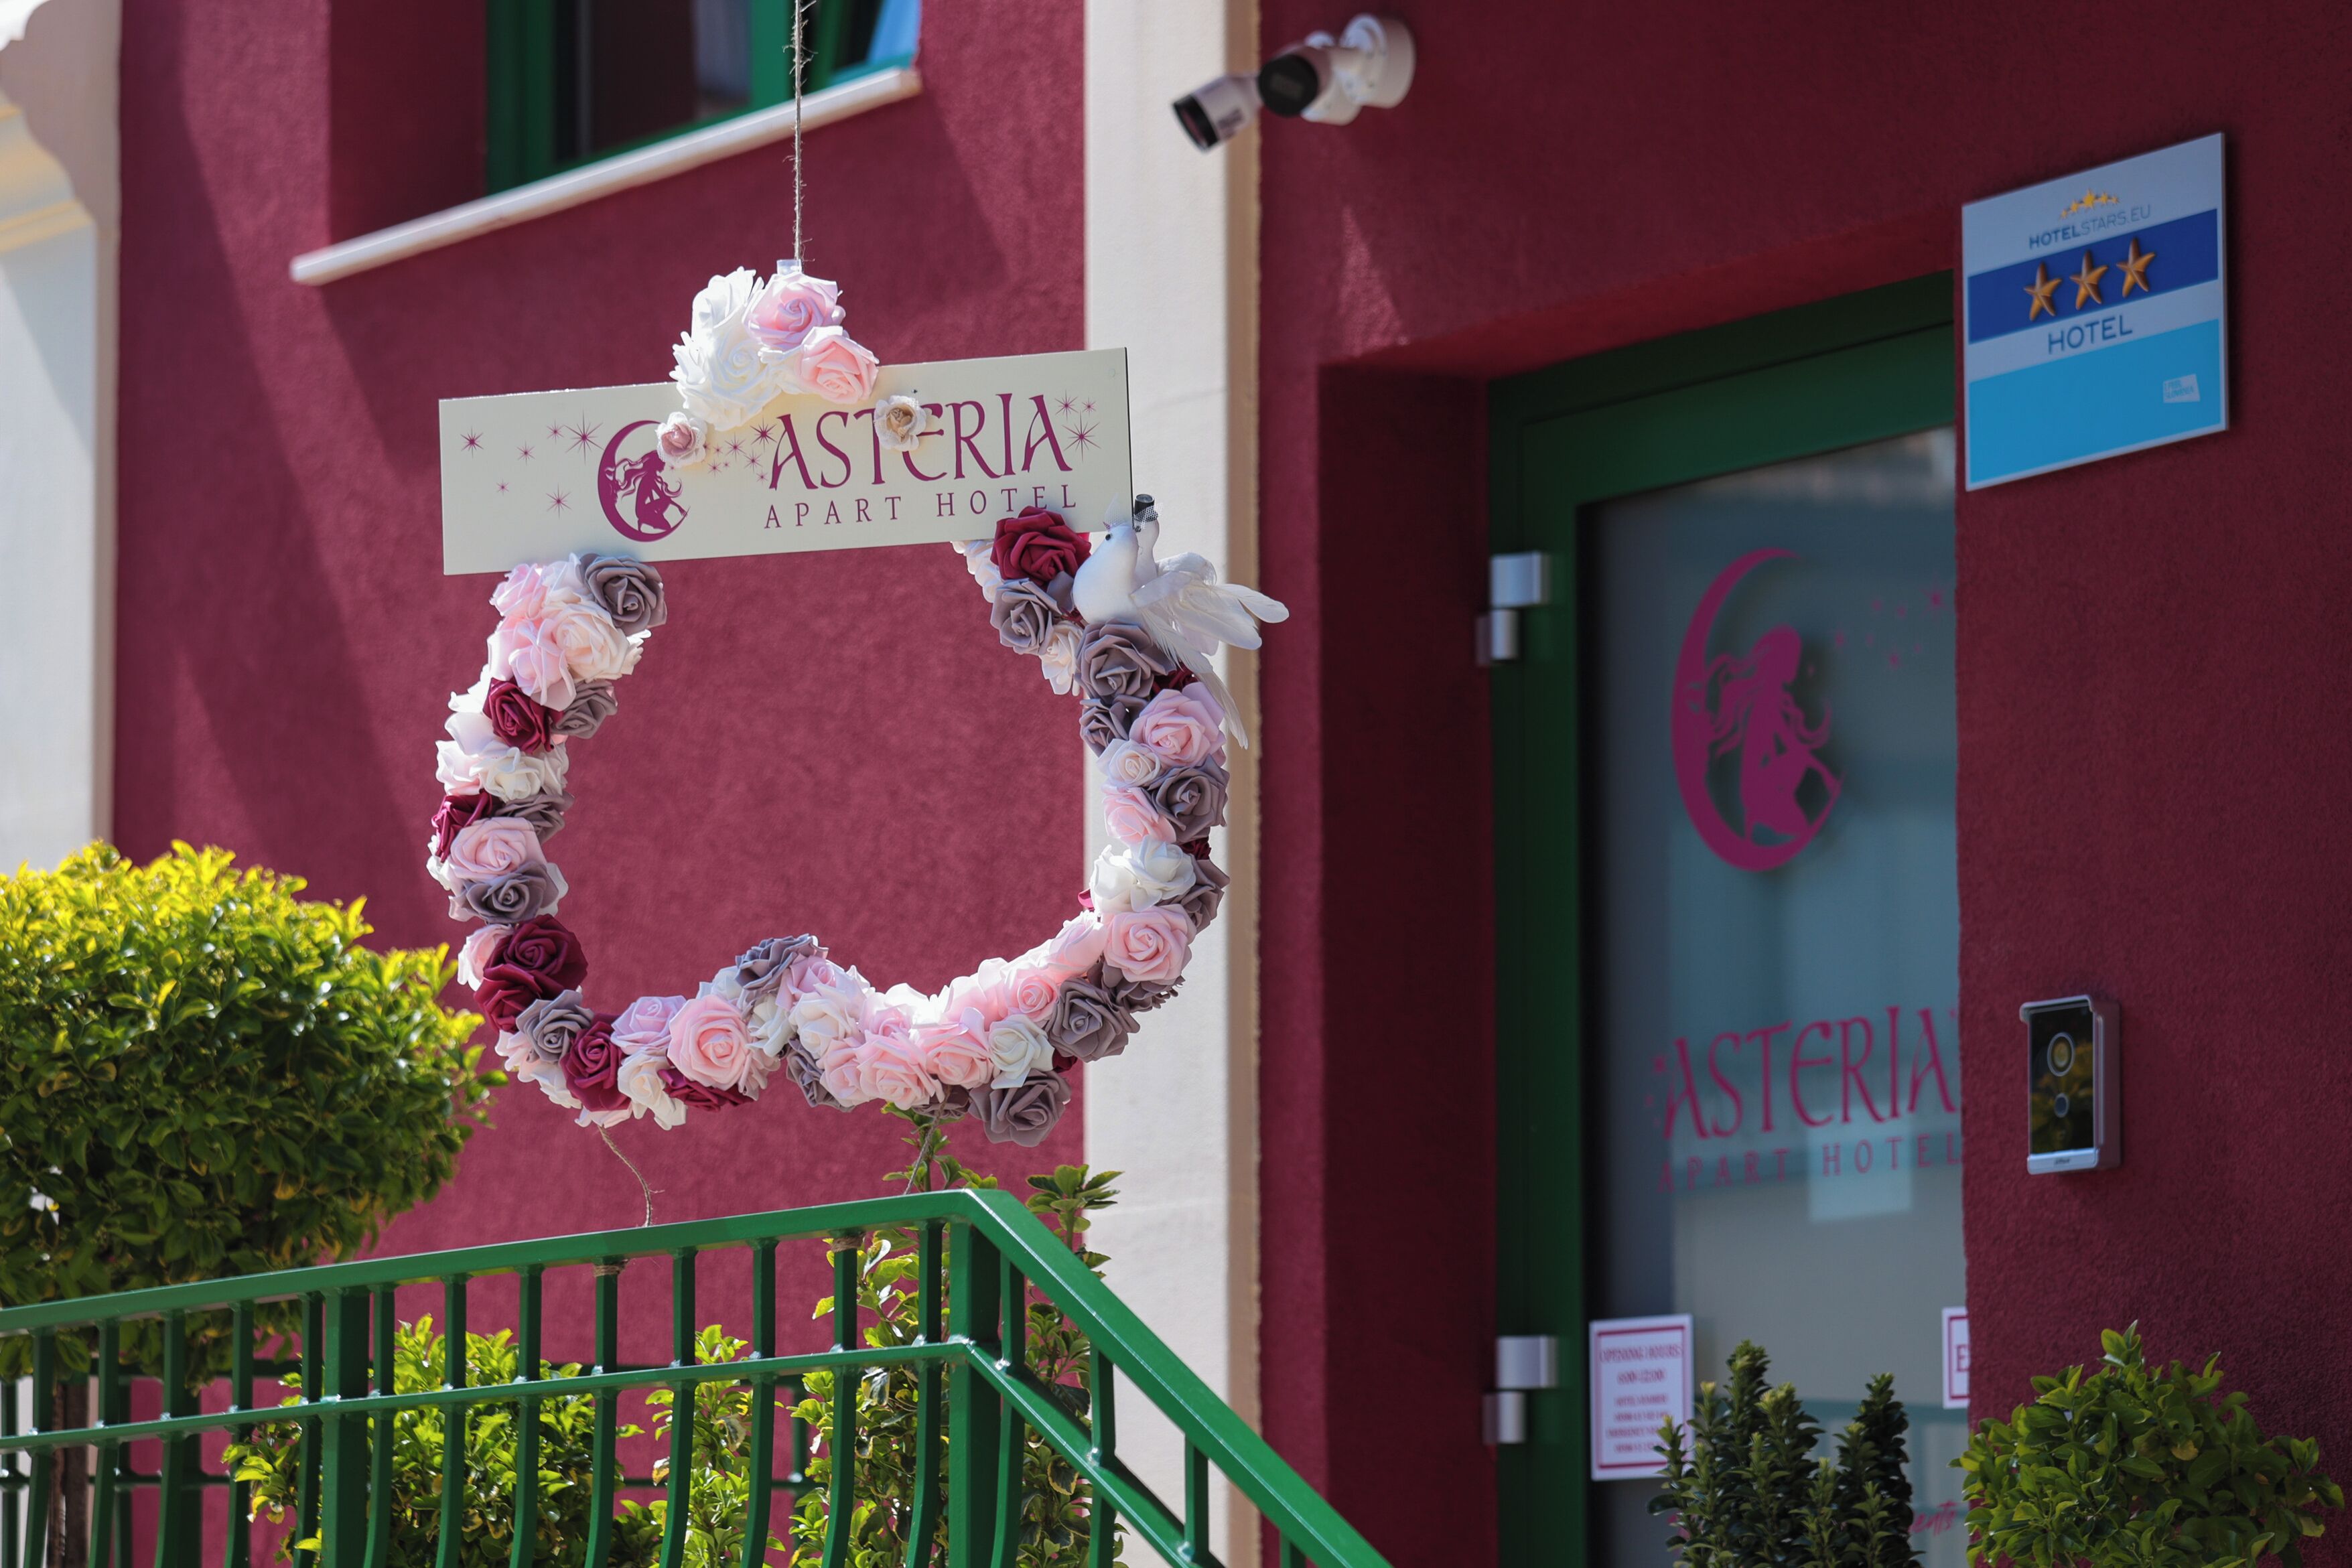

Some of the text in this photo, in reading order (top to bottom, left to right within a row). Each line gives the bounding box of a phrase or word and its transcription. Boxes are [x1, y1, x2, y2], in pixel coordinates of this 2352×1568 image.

[2029, 204, 2151, 249] HOTELSTARS.EU
[2048, 314, 2133, 355] HOTEL
[768, 393, 1073, 491] ASTERIA
[764, 484, 1077, 529] APART HOTEL
[1662, 1005, 1958, 1140] ASTERIA
[1657, 1132, 1963, 1194] APART HOTEL
